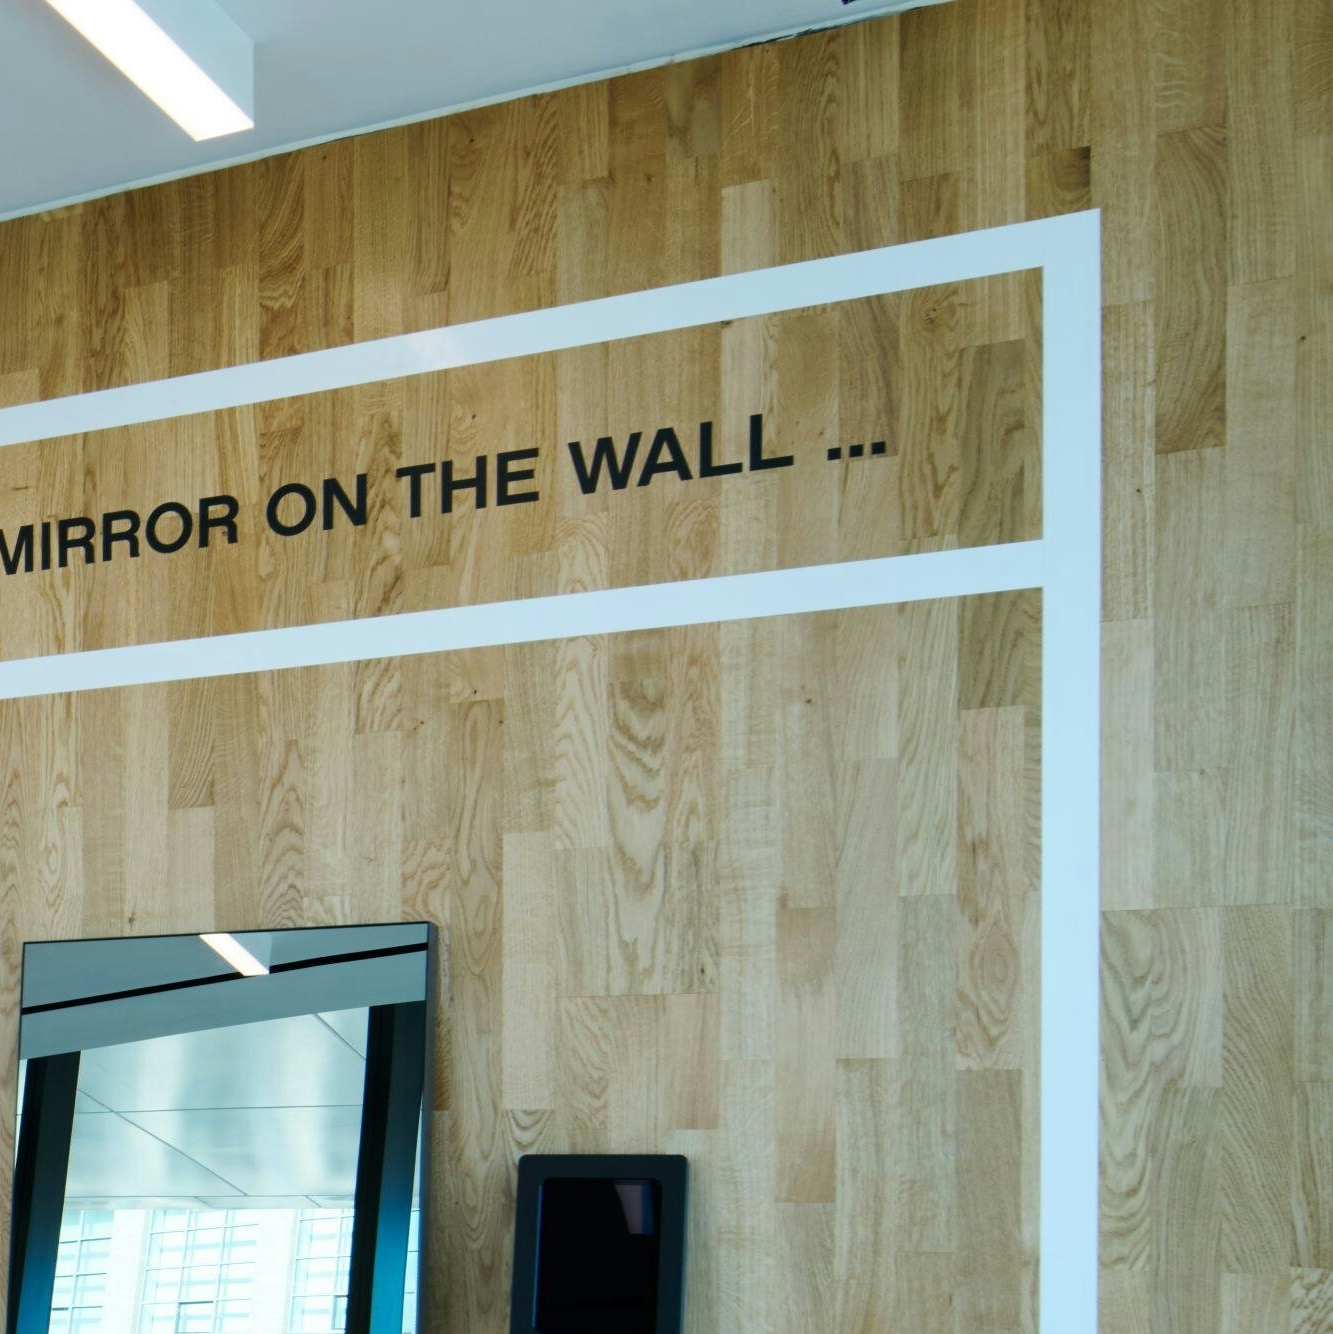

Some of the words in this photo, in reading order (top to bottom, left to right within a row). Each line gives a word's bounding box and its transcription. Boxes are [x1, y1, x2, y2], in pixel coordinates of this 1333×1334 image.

[266, 472, 369, 537] ON
[395, 447, 541, 519] THE
[567, 413, 795, 495] WALL
